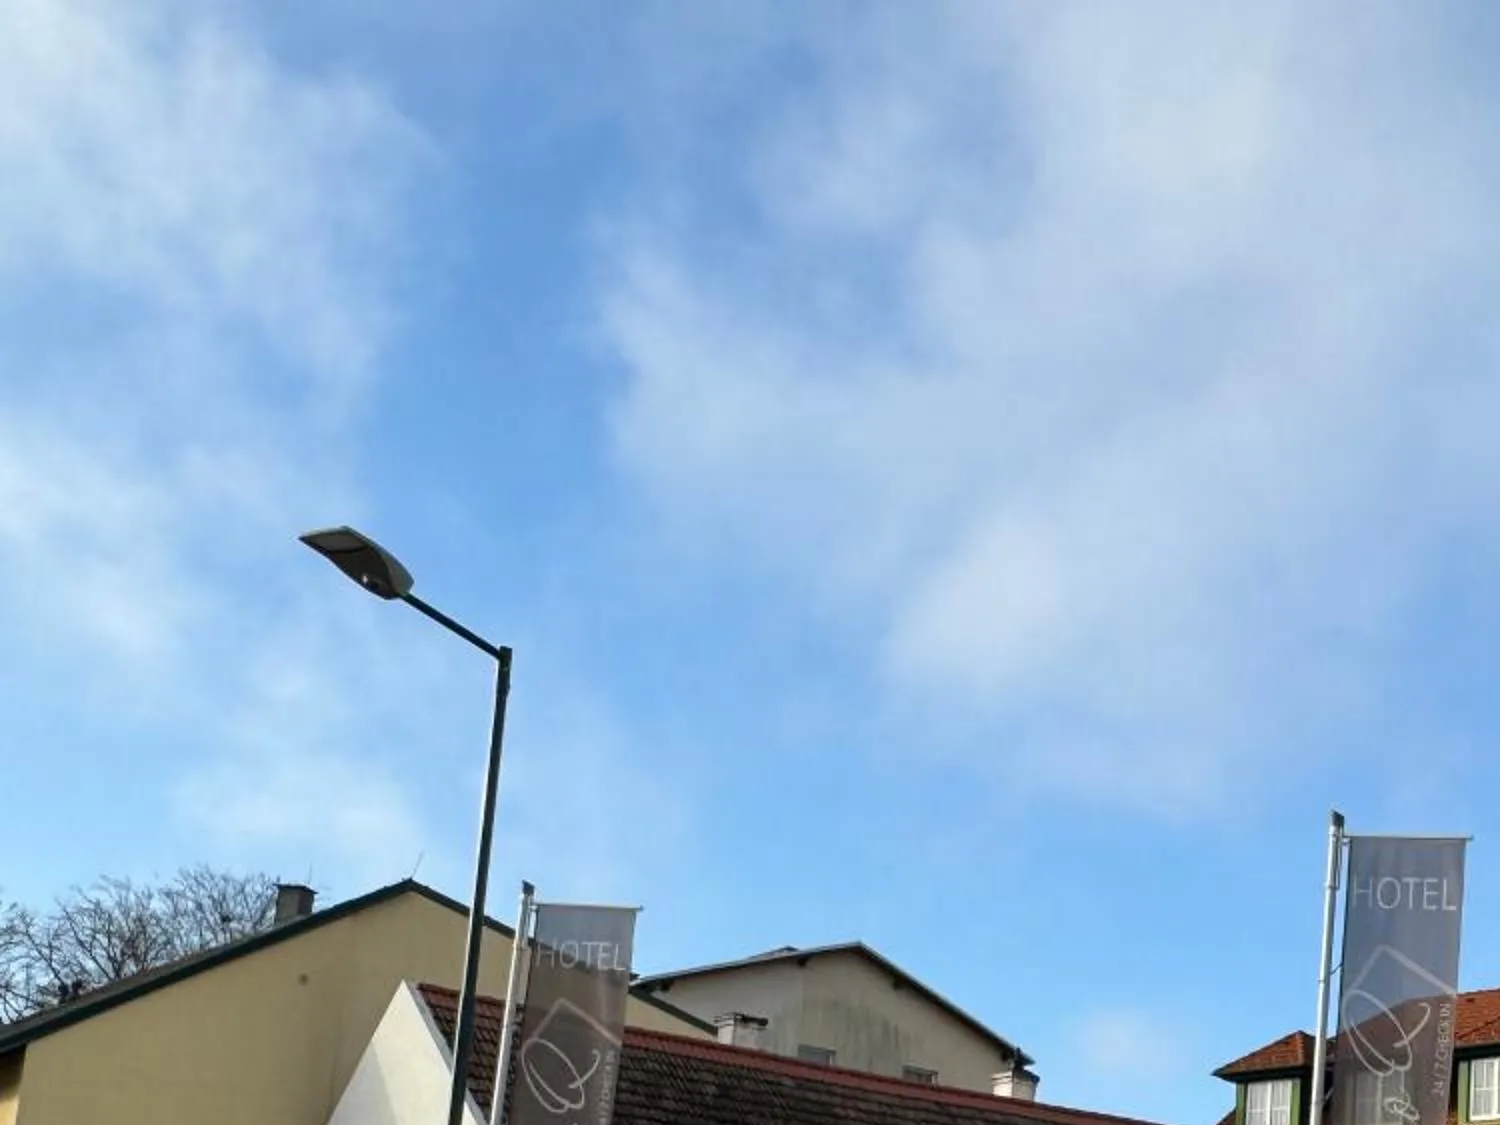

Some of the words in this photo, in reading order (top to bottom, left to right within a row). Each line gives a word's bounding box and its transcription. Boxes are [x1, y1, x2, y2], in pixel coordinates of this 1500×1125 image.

[1352, 876, 1458, 912] HOTEL
[535, 938, 628, 971] HOTEL
[1342, 988, 1432, 1078] Q
[521, 1037, 601, 1114] Q
